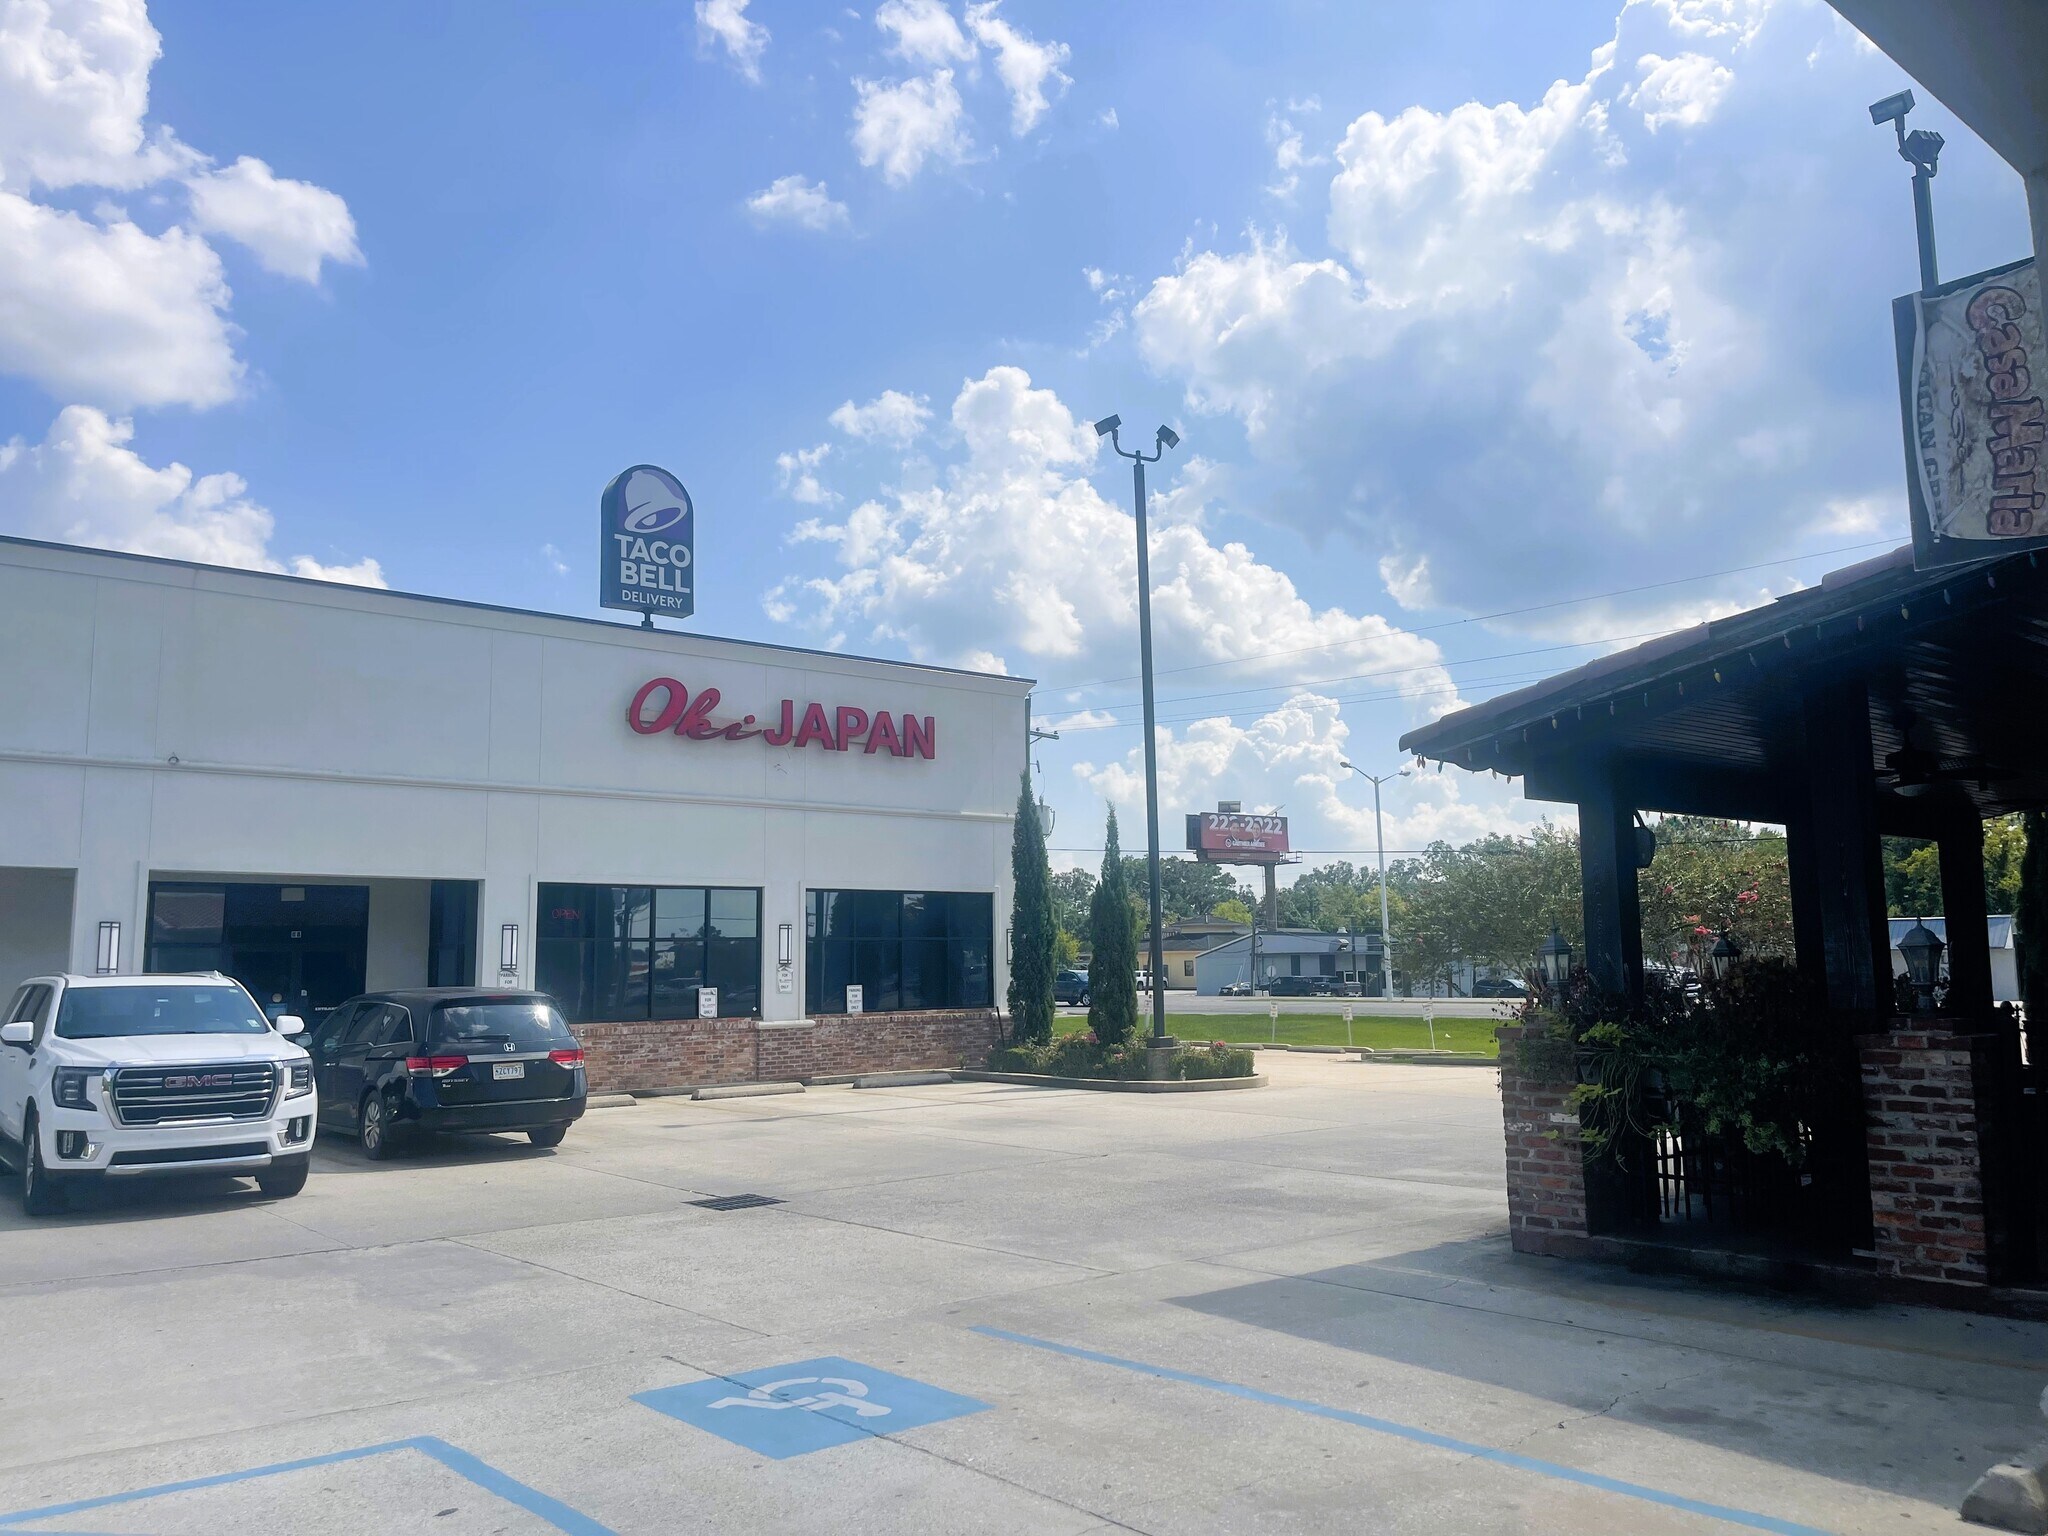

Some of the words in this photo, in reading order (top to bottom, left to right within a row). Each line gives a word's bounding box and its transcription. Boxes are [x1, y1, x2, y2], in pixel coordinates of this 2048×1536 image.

[1966, 285, 2028, 401] Casa
[1986, 396, 2046, 536] Maria
[614, 533, 691, 568] TACO
[620, 561, 690, 593] BELL
[622, 589, 683, 609] DELIVERY
[629, 677, 763, 741] Oki
[763, 699, 935, 760] JAPAN
[551, 908, 580, 920] OPEN
[165, 1074, 233, 1089] GMC
